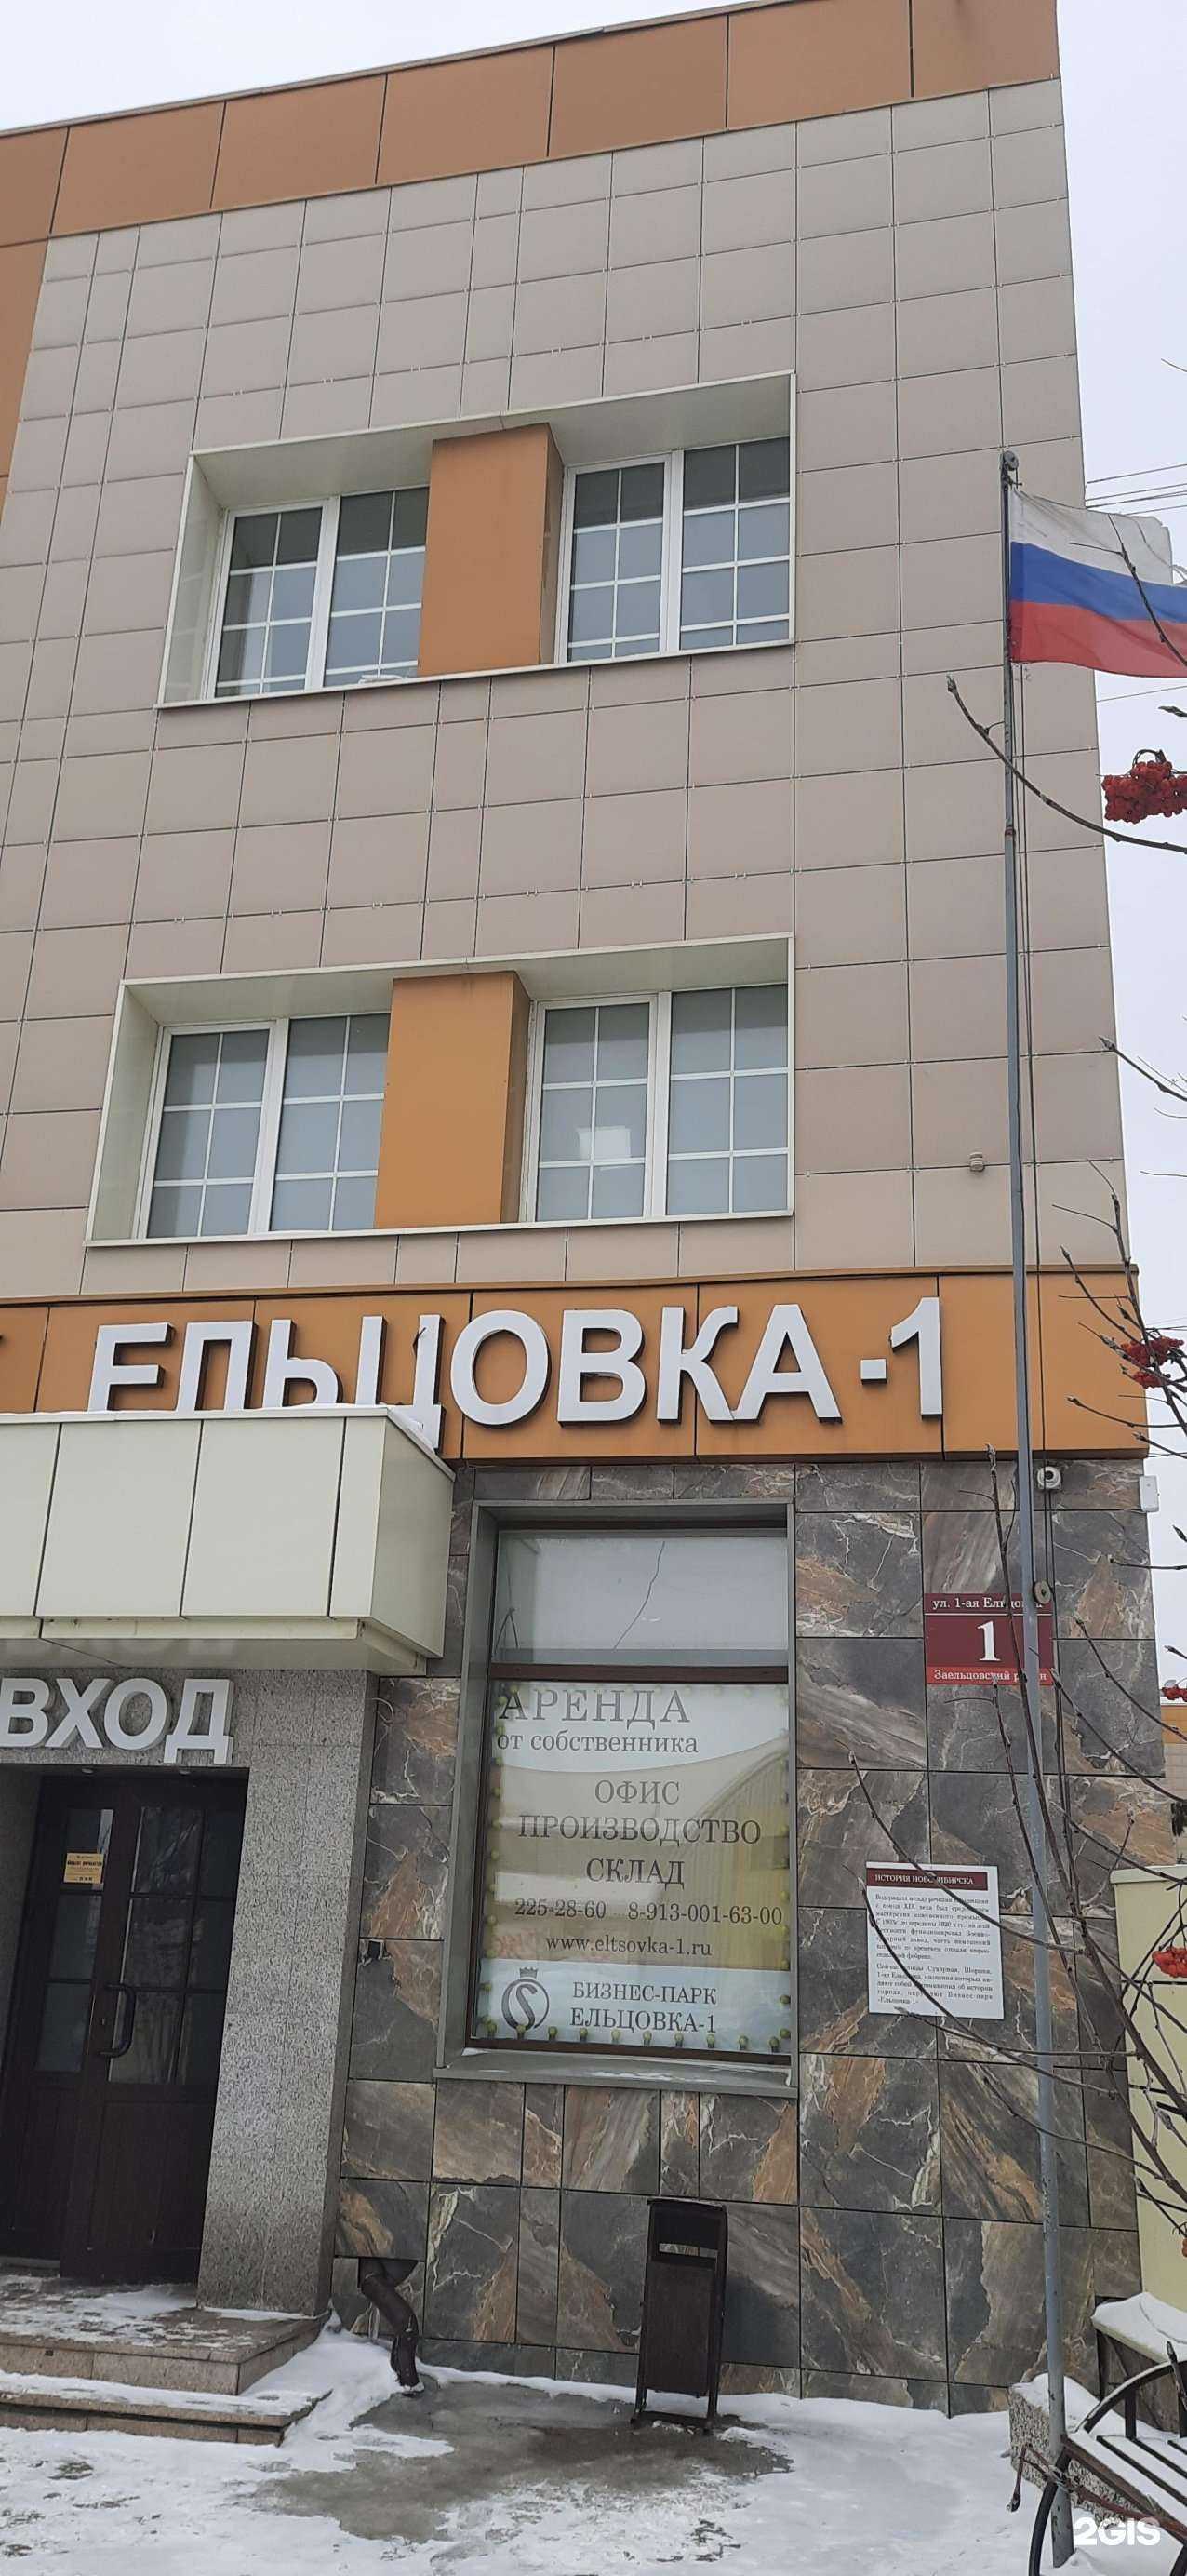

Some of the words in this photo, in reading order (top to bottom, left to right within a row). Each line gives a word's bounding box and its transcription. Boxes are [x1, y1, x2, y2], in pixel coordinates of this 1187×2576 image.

[932, 1600, 950, 1610] ул.
[955, 1597, 979, 1608] 1-ая
[977, 1620, 1001, 1661] 1
[0, 1678, 230, 1764] ВХОД
[499, 1688, 690, 1730] АРЕНДА
[497, 1734, 523, 1751] от
[530, 1729, 699, 1753] собственника
[594, 1779, 680, 1805] ОФИС
[518, 1814, 761, 1846] ПРОИЗВОДСТВО
[585, 1858, 685, 1889] СКЛАД
[875, 1873, 912, 1883] ИСТОРИЯ
[913, 1875, 974, 1885] НОВИБИРСКА
[514, 1898, 607, 1920] 225-28-60
[628, 1903, 782, 1925] 8-913-001-63-00
[545, 1933, 713, 1957] www.eltsovka-1.ru
[572, 1980, 717, 2006] БИЗНЕС-ПАРК
[569, 2007, 717, 2033] ЕЛЬЦОВКА-1
